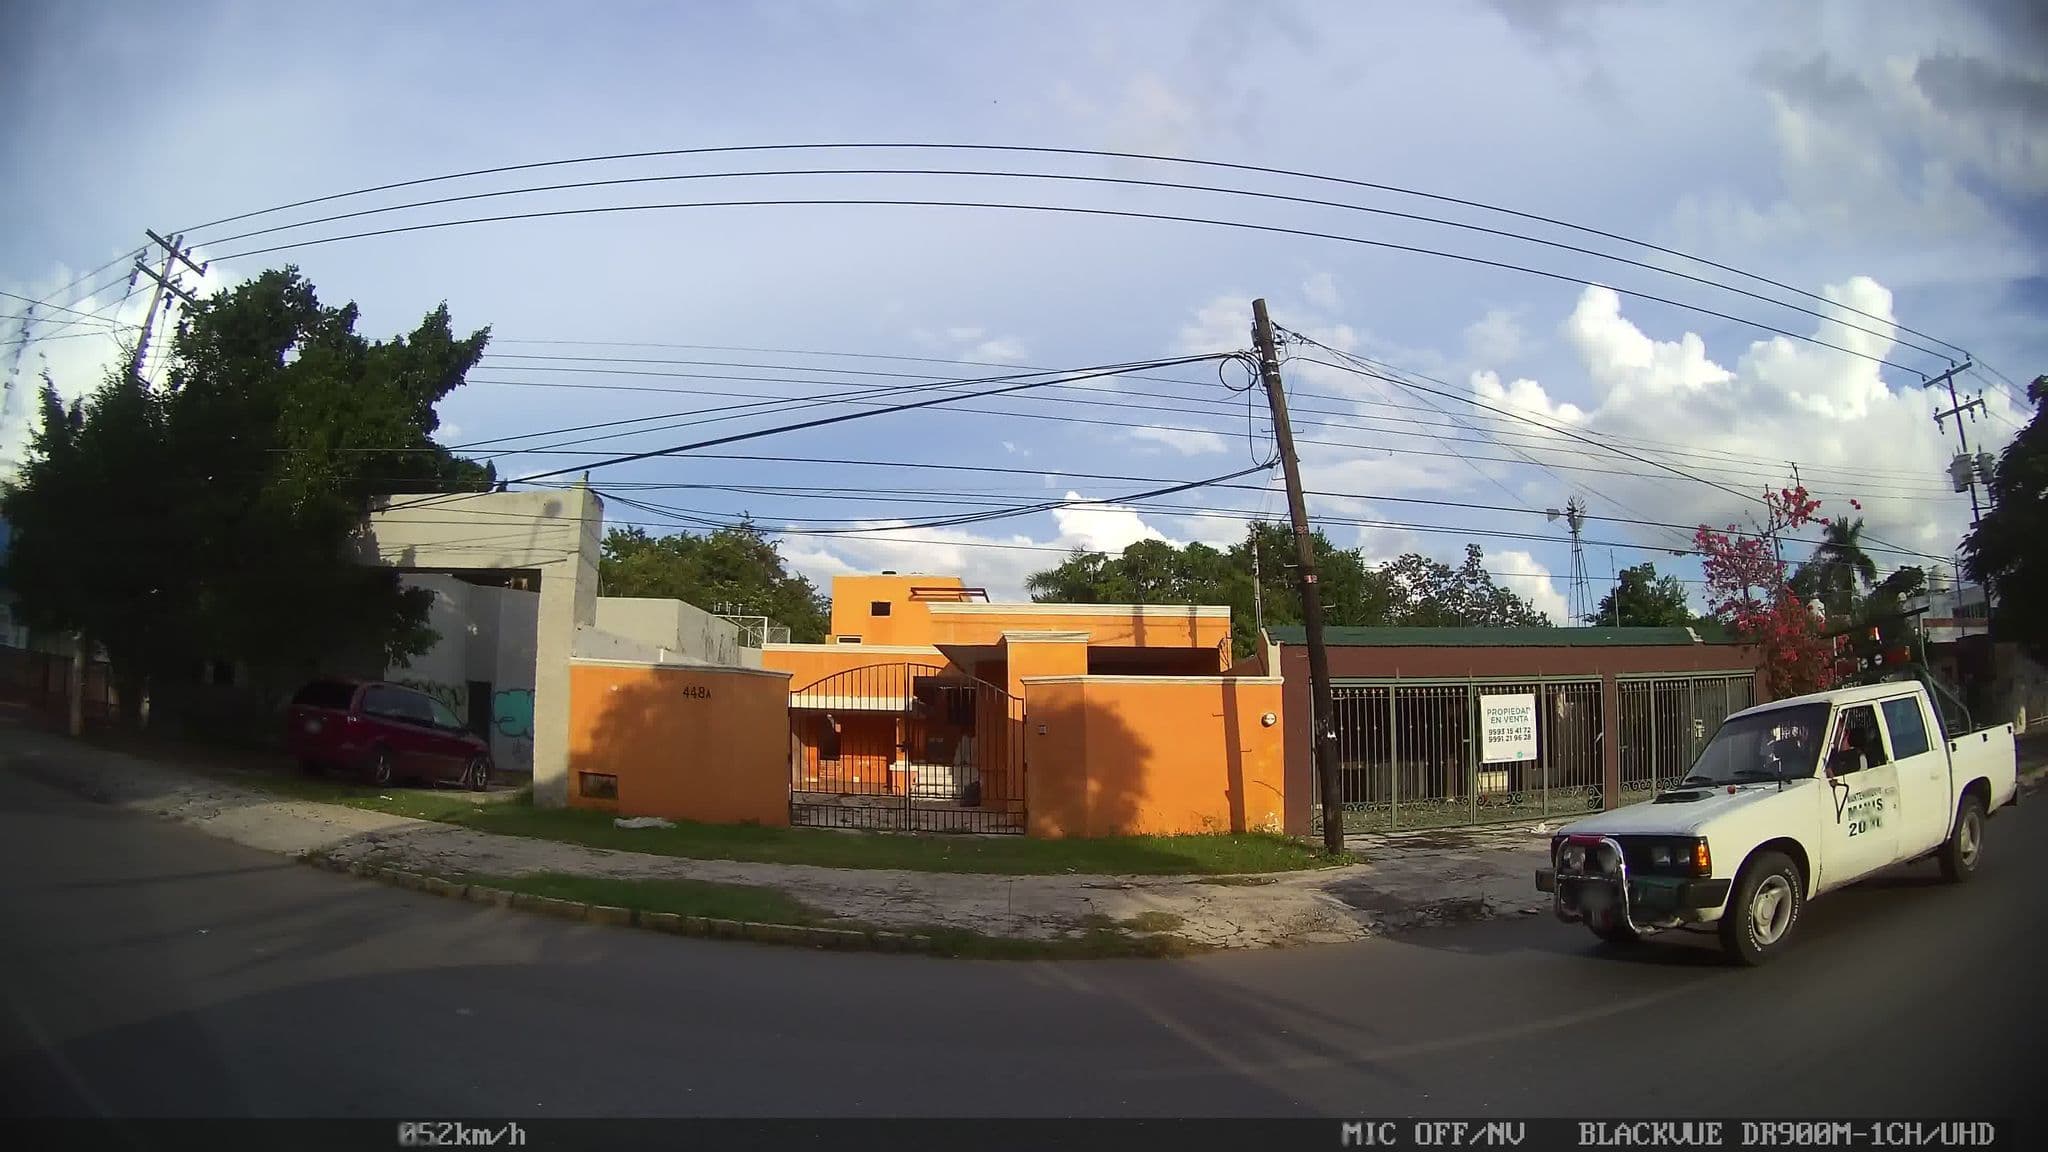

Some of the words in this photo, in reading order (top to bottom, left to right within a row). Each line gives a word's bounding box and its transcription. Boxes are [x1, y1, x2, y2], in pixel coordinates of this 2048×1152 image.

[683, 686, 712, 699] 448A
[1490, 716, 1502, 724] EN
[1504, 715, 1529, 723] VENTA
